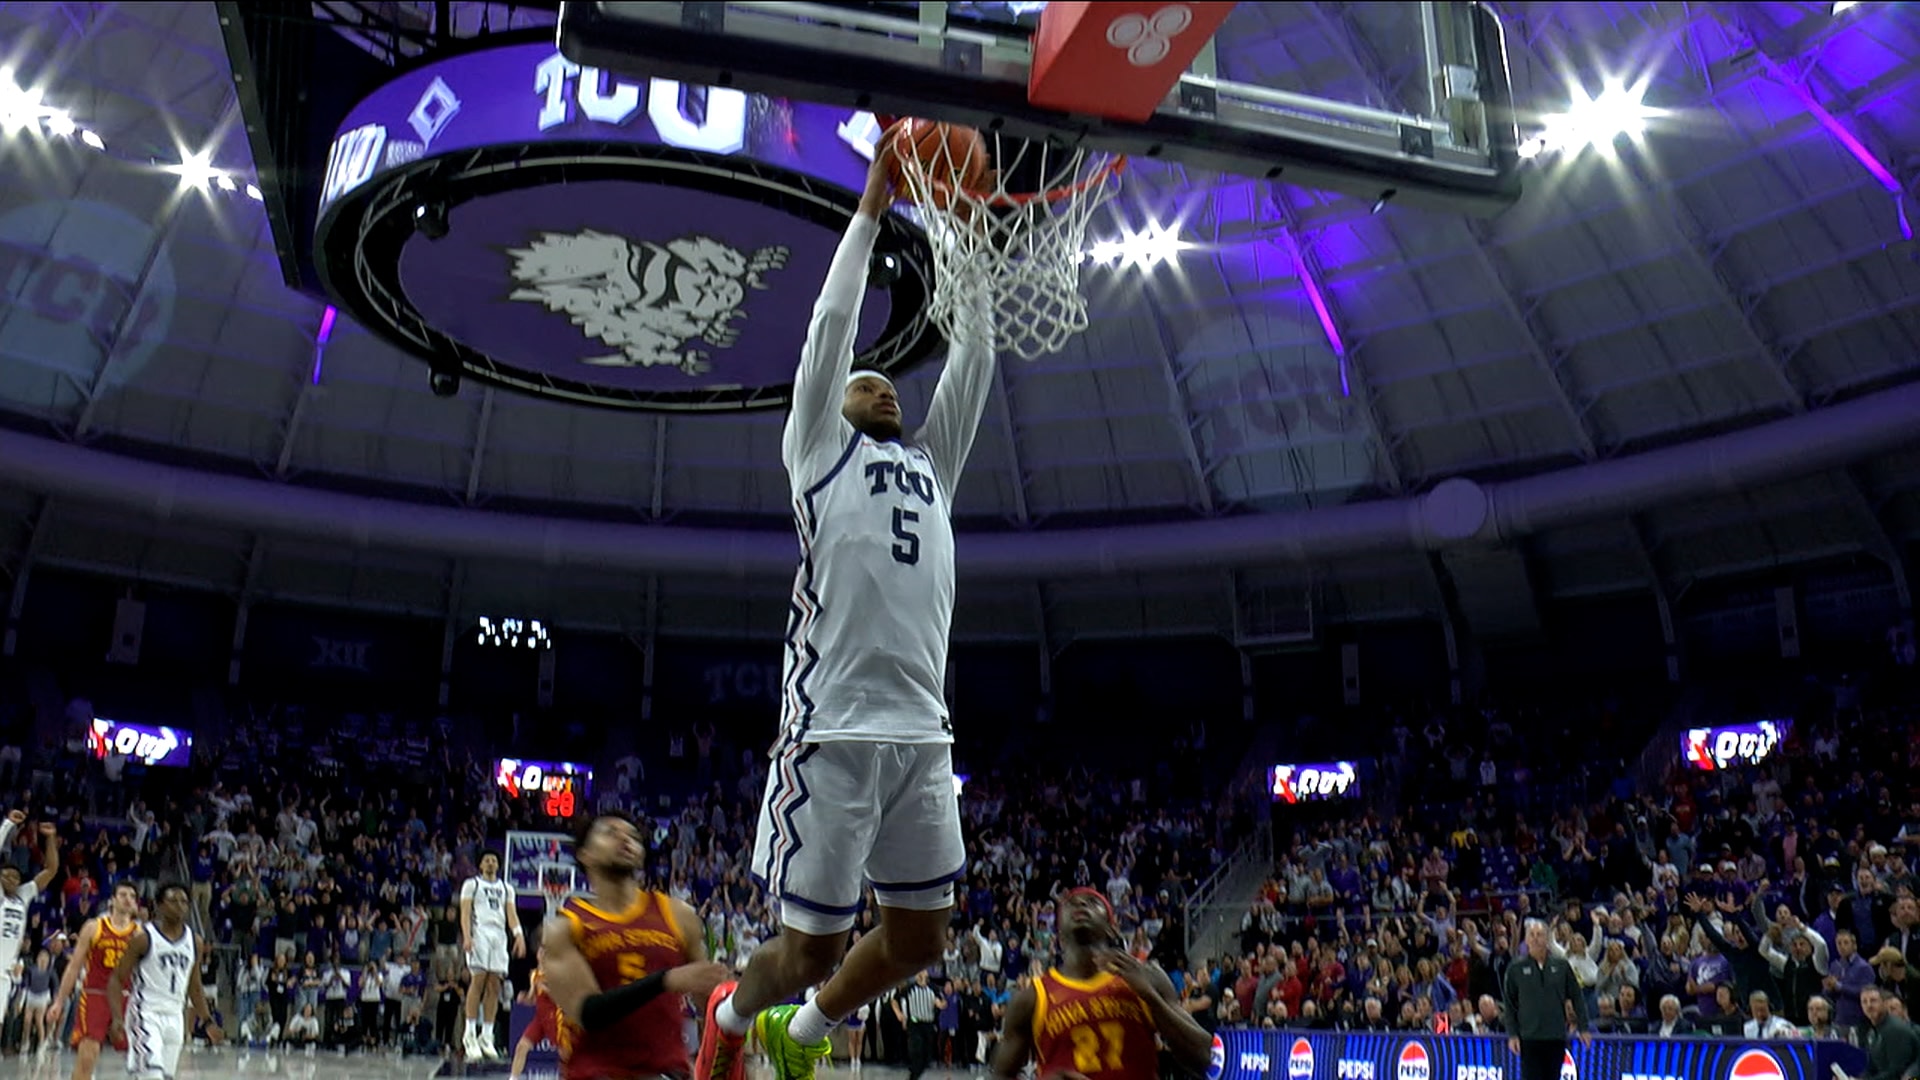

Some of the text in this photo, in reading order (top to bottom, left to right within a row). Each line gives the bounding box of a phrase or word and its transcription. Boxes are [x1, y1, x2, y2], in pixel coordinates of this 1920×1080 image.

[534, 53, 748, 155] TCU
[865, 461, 934, 506] TCU
[892, 506, 920, 566] 5
[1241, 1052, 1270, 1072] PEPSI
[1338, 1060, 1374, 1080] PEPSI
[1400, 1063, 1427, 1078] PEPSI
[1457, 1064, 1503, 1080] PEPSI
